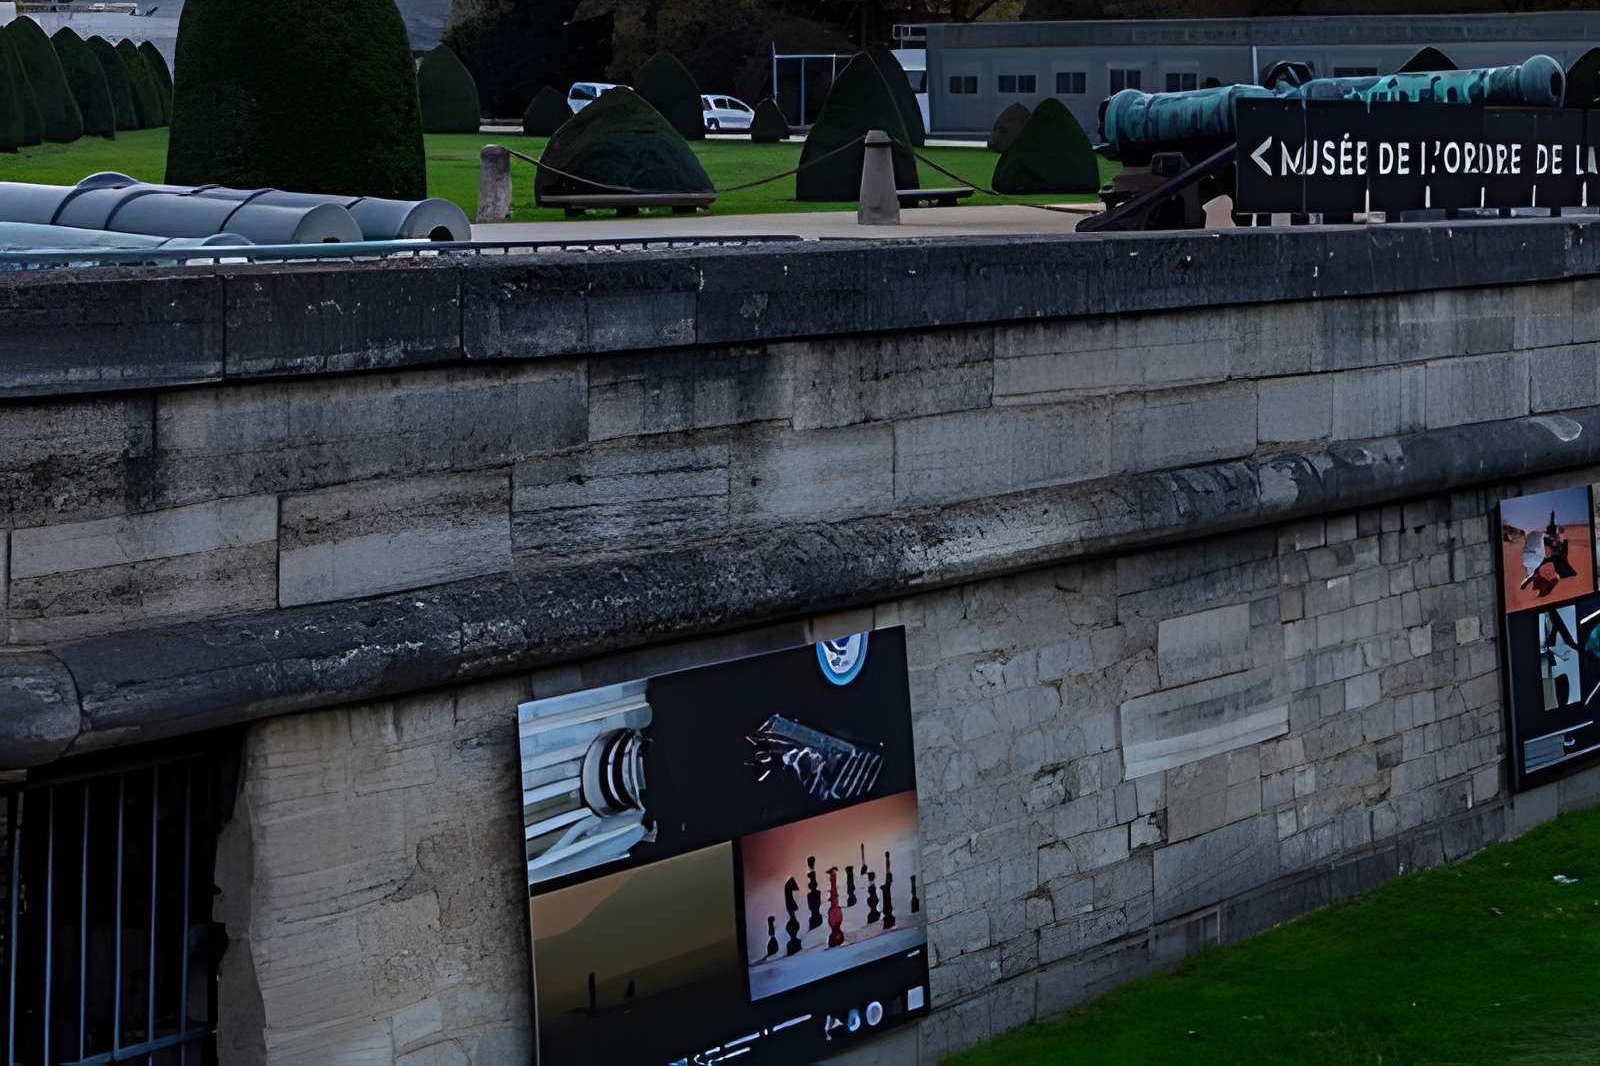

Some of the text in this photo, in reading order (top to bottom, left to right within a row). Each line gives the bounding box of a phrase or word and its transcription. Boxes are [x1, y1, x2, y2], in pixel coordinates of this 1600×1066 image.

[1280, 132, 1368, 176] MUSÉE
[1378, 141, 1410, 175] DE
[1535, 143, 1563, 175] DE
